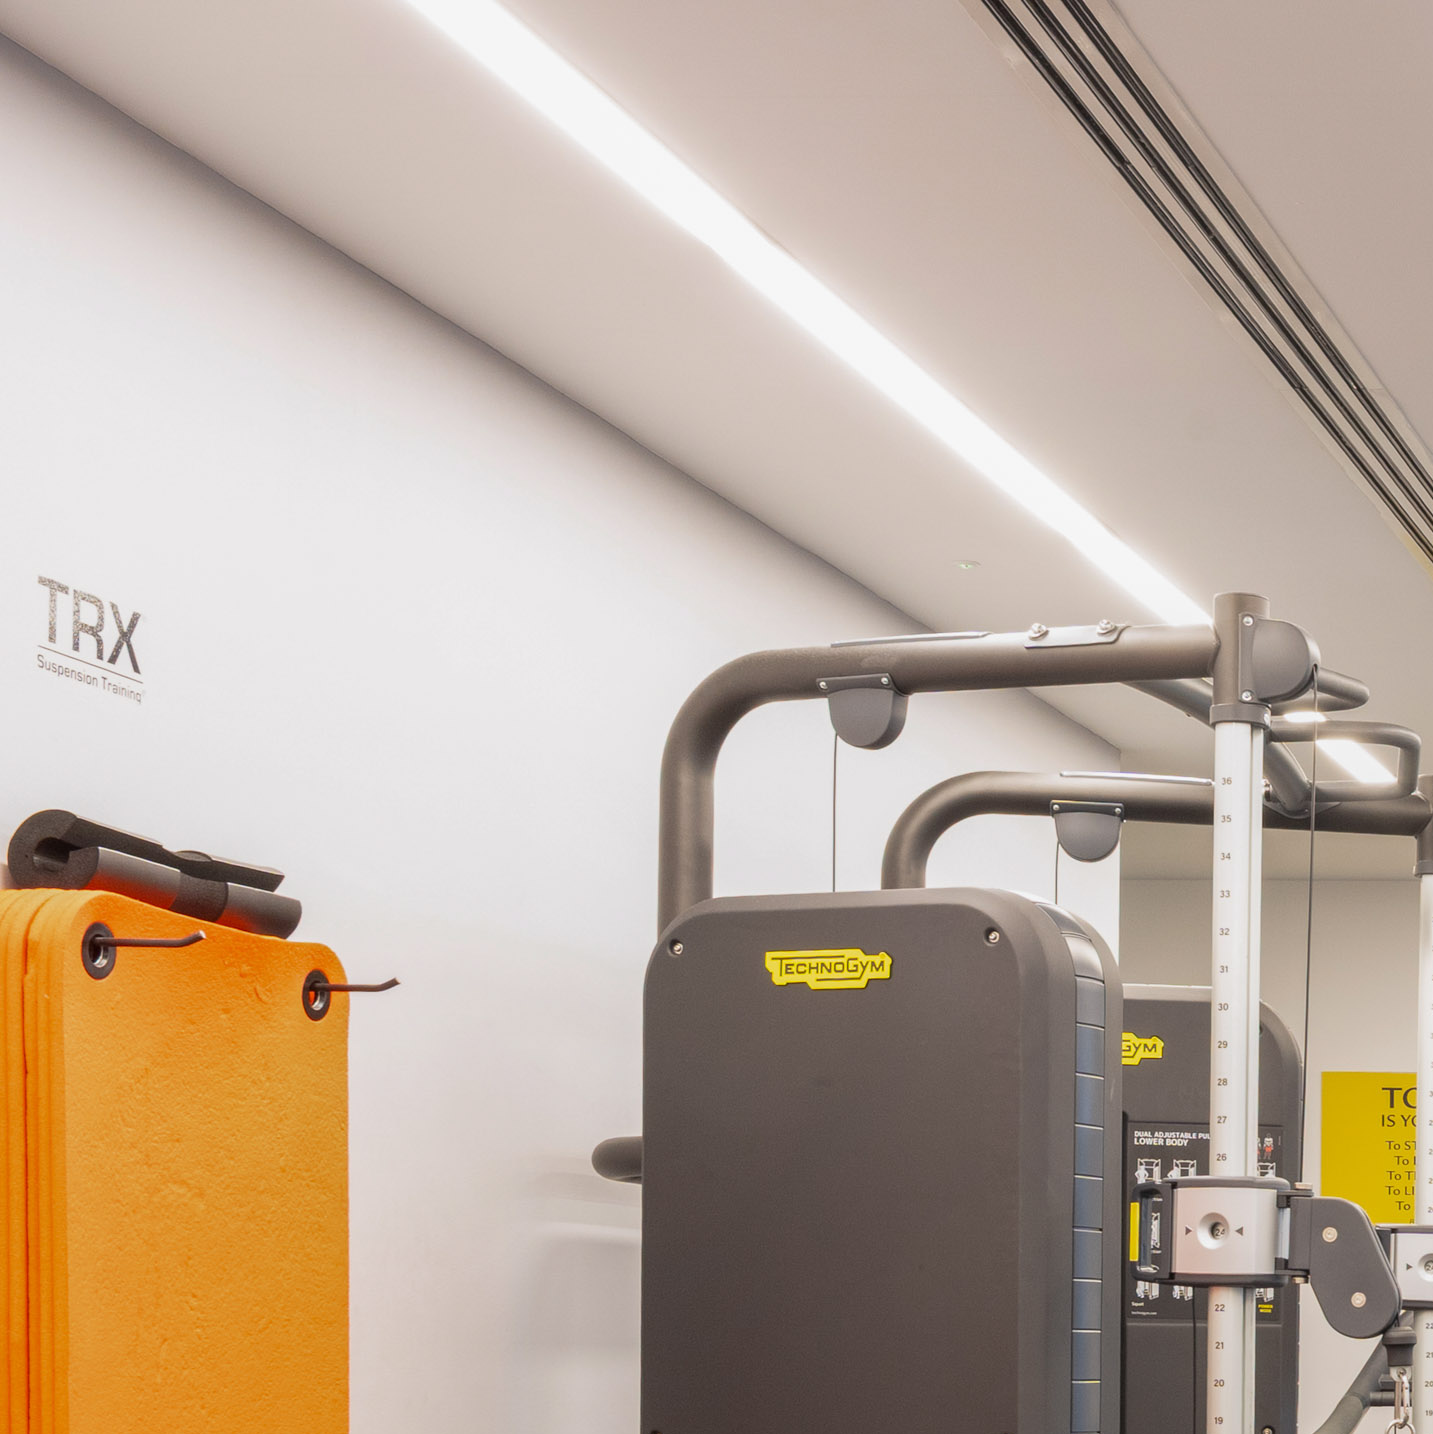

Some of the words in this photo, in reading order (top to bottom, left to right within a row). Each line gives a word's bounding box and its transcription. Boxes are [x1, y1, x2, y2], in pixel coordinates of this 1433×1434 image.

[38, 575, 141, 675] TRX
[37, 653, 98, 687] Suspension
[101, 676, 141, 704] Training
[1221, 776, 1233, 786] 36
[1221, 814, 1232, 824] 35
[1220, 852, 1232, 861] 34
[1219, 889, 1231, 899] 33
[1219, 927, 1230, 936] 32
[1219, 964, 1229, 974] 31
[1217, 1002, 1229, 1012] 30
[1217, 1040, 1228, 1049] 29
[1217, 1077, 1228, 1087] 28
[1216, 1115, 1228, 1124] 27
[1381, 1114, 1396, 1128] IS
[1154, 1131, 1197, 1139] ADJUSTABLE
[1198, 1132, 1210, 1140] PUL
[1134, 1138, 1164, 1146] LOWER
[1165, 1139, 1189, 1147] BODY
[1386, 1141, 1401, 1151] To
[1216, 1153, 1228, 1162] 26
[1394, 1156, 1409, 1166] To
[1386, 1171, 1402, 1181] To
[1385, 1186, 1401, 1196] To
[1395, 1201, 1411, 1211] To
[1214, 1227, 1226, 1237] 24
[1214, 1303, 1226, 1312] 22
[1215, 1341, 1224, 1350] 21
[1425, 1351, 1433, 1359] 21
[1213, 1378, 1225, 1388] 20
[1425, 1409, 1433, 1417] 19
[1214, 1416, 1224, 1425] 19
